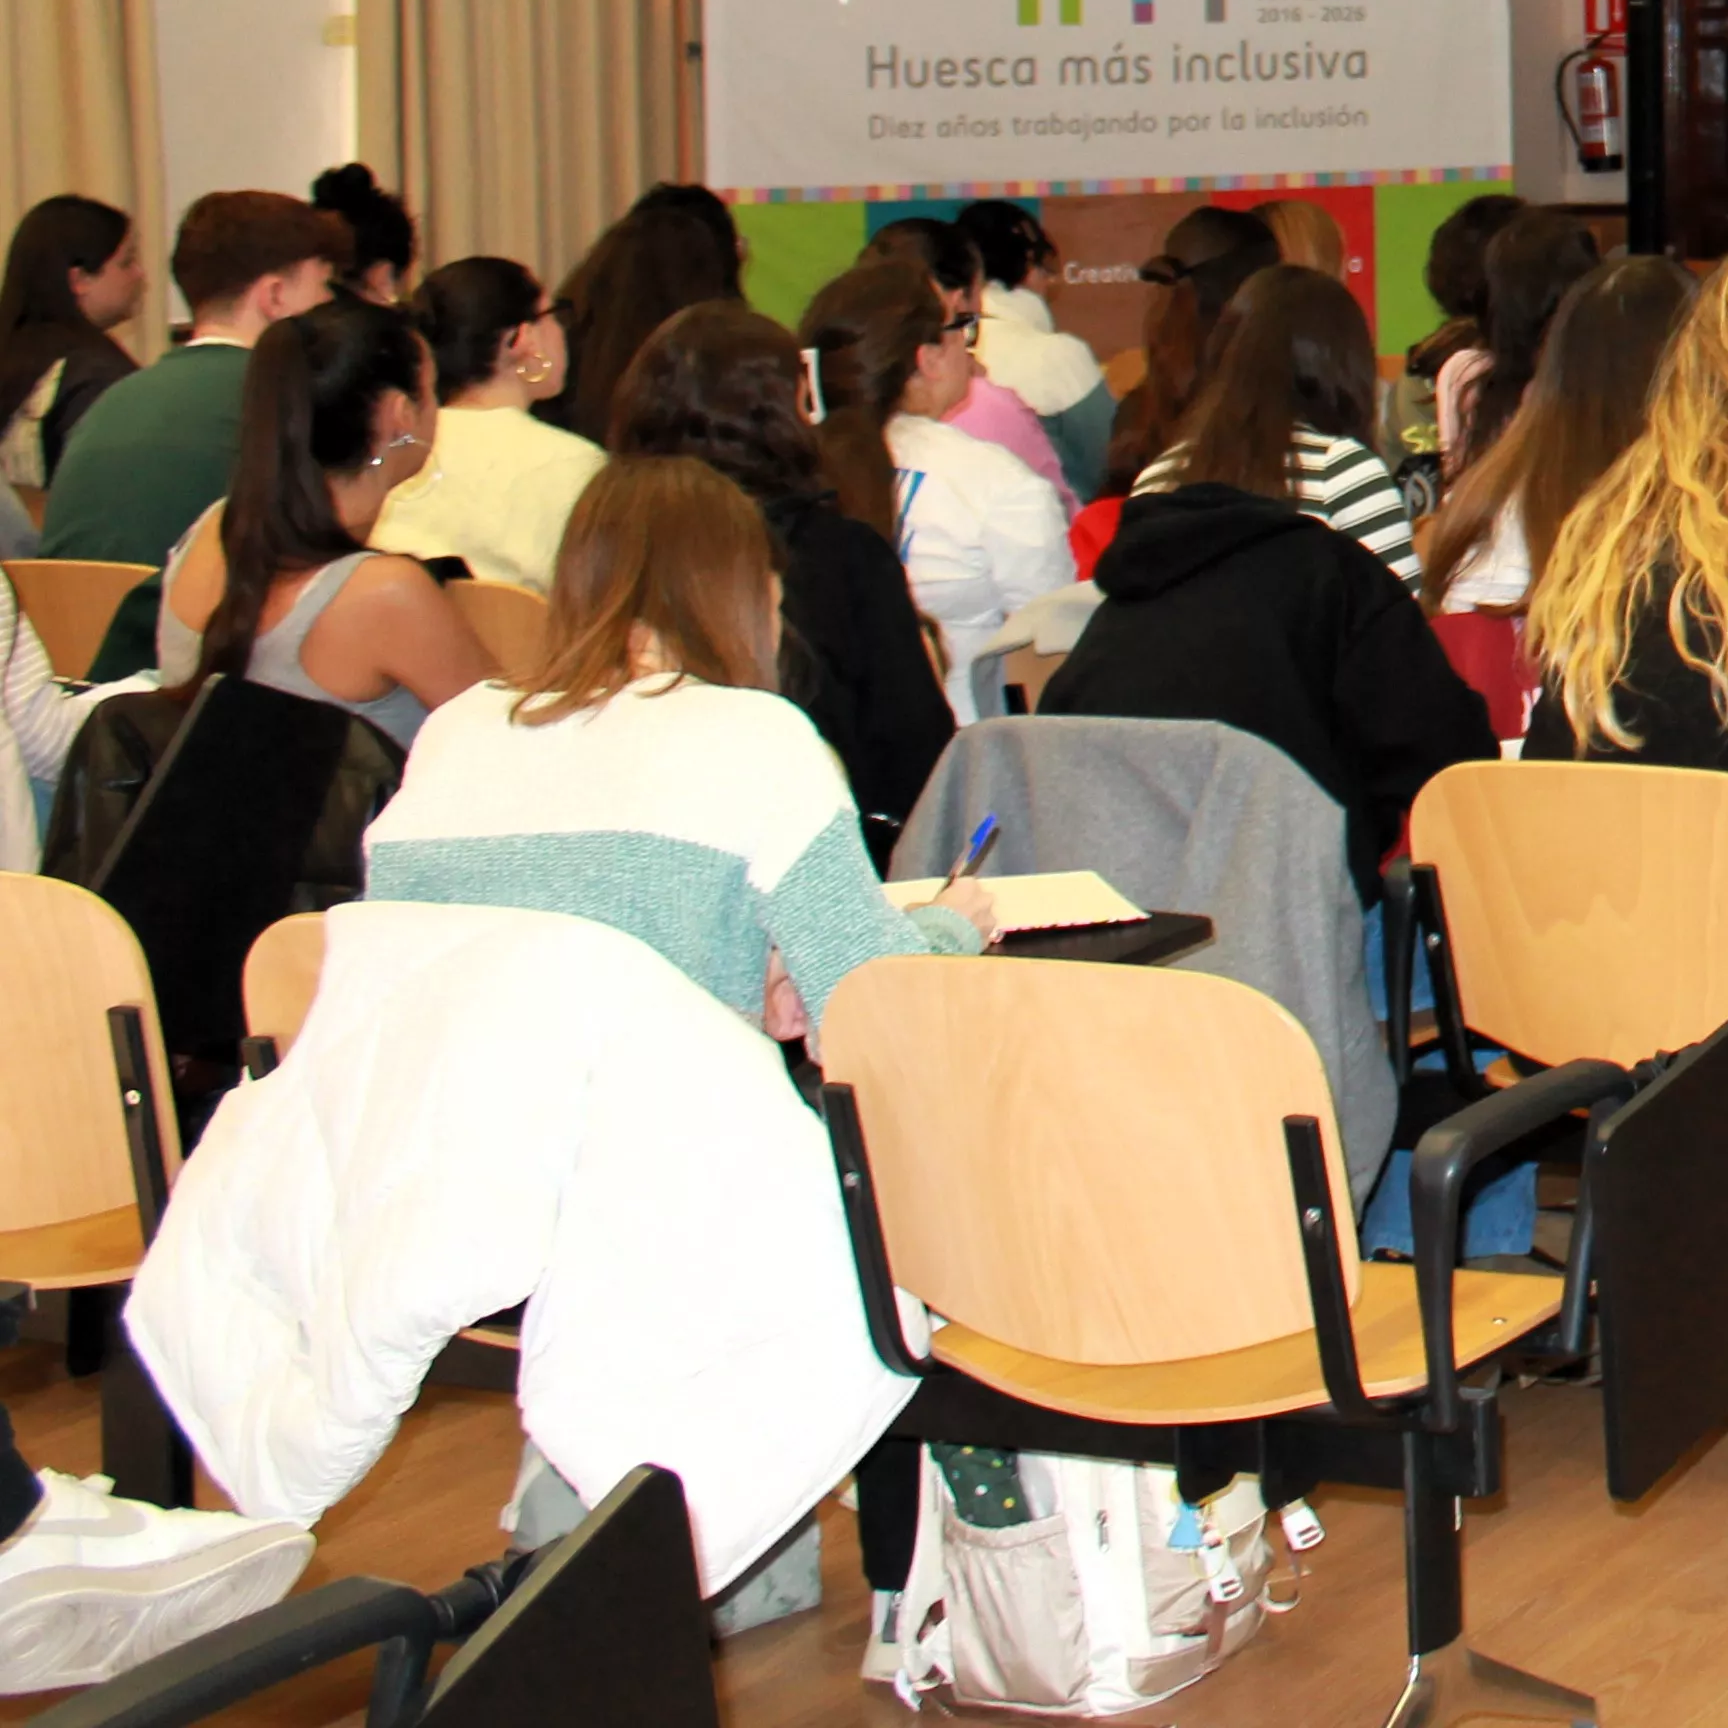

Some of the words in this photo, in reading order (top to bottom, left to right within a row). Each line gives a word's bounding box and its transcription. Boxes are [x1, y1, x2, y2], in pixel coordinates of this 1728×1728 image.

[866, 44, 1038, 90] Huesca
[1058, 41, 1153, 86] más
[1172, 39, 1369, 84] inclusiva
[868, 113, 925, 140] Diez
[936, 111, 1002, 139] años
[1012, 110, 1157, 143] trabajando
[1167, 114, 1211, 139] por
[1222, 107, 1246, 132] la
[1255, 104, 1369, 130] inclusión
